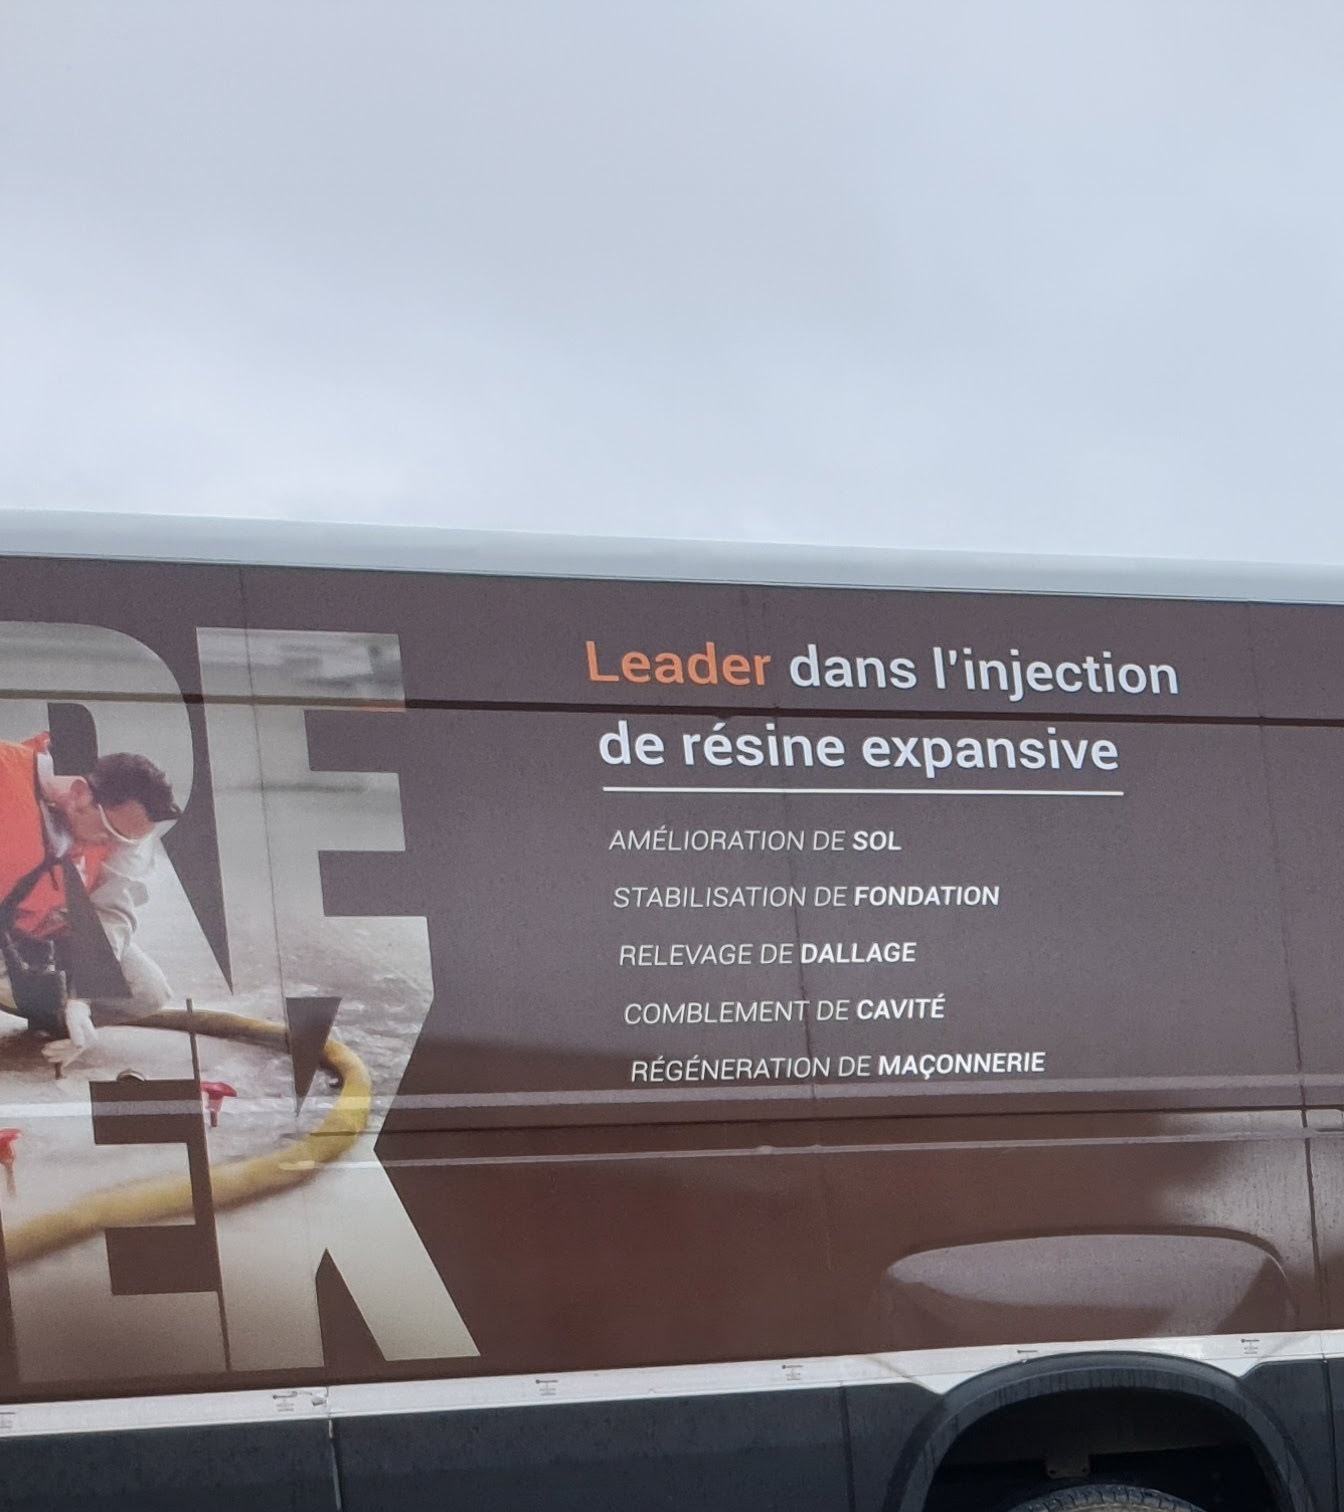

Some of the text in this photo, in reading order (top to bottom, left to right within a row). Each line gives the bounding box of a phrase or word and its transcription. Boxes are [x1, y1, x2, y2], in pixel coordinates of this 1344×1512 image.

[585, 640, 1179, 702] Leader dans l'injection
[599, 721, 1120, 778] de résine expansive
[609, 825, 902, 852] AMÉLIORATION DE SOL
[613, 885, 1000, 909] STABILISATION DE FONDATION
[619, 942, 917, 966] RELEVAGE DE DALLAGE
[624, 993, 945, 1025] COMBLEMENT DE CAVITÉ
[630, 1052, 1045, 1083] RÉGÉNERATION DE MAÇONNERIE
